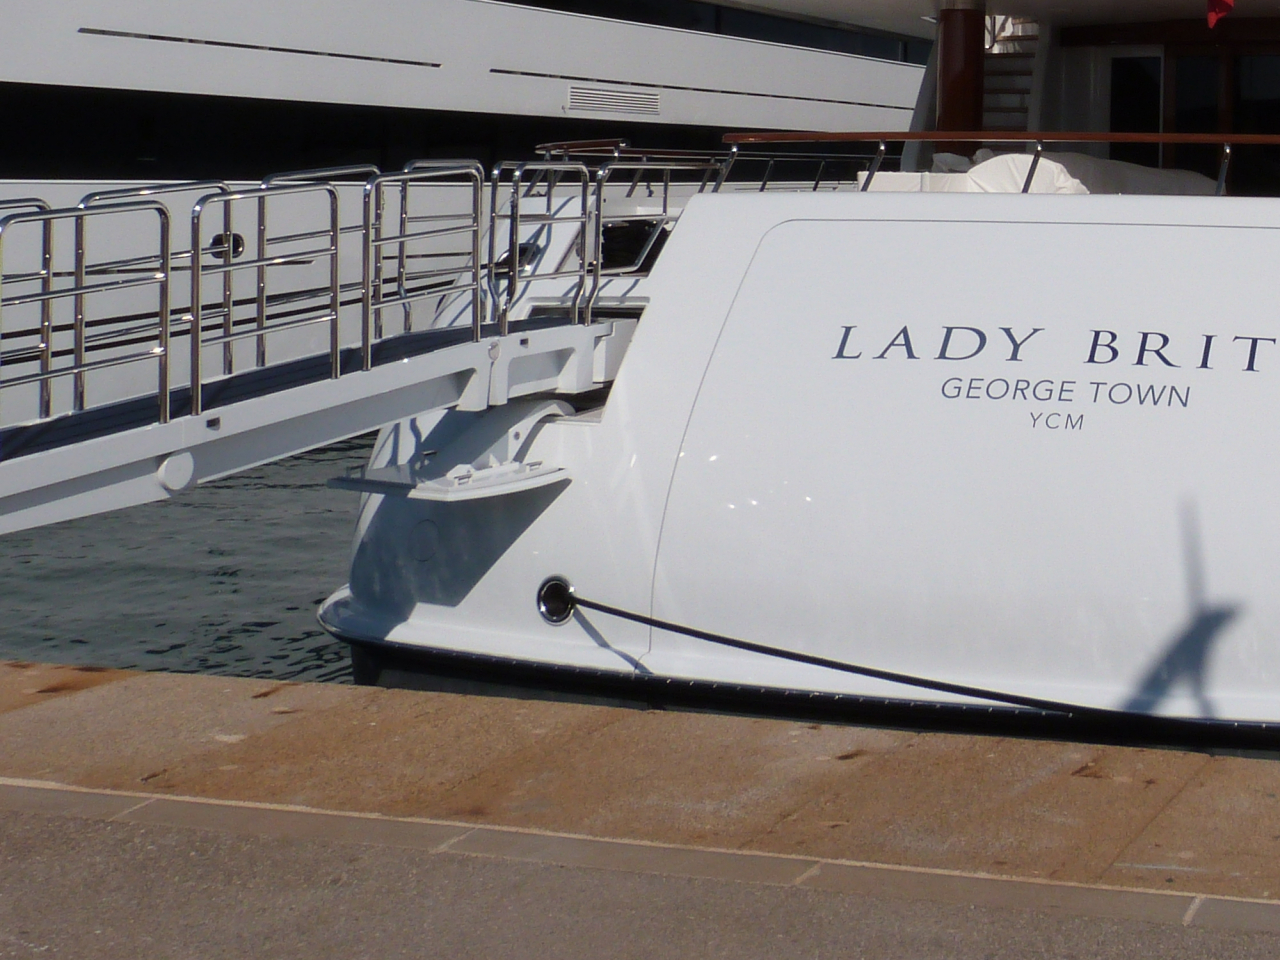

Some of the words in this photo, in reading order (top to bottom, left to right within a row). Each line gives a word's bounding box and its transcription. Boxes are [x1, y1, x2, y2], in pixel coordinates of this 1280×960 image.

[831, 325, 1046, 362] LADY
[940, 376, 1077, 403] GEORGE
[1089, 381, 1191, 408] TOWN
[1029, 411, 1085, 431] YCM
